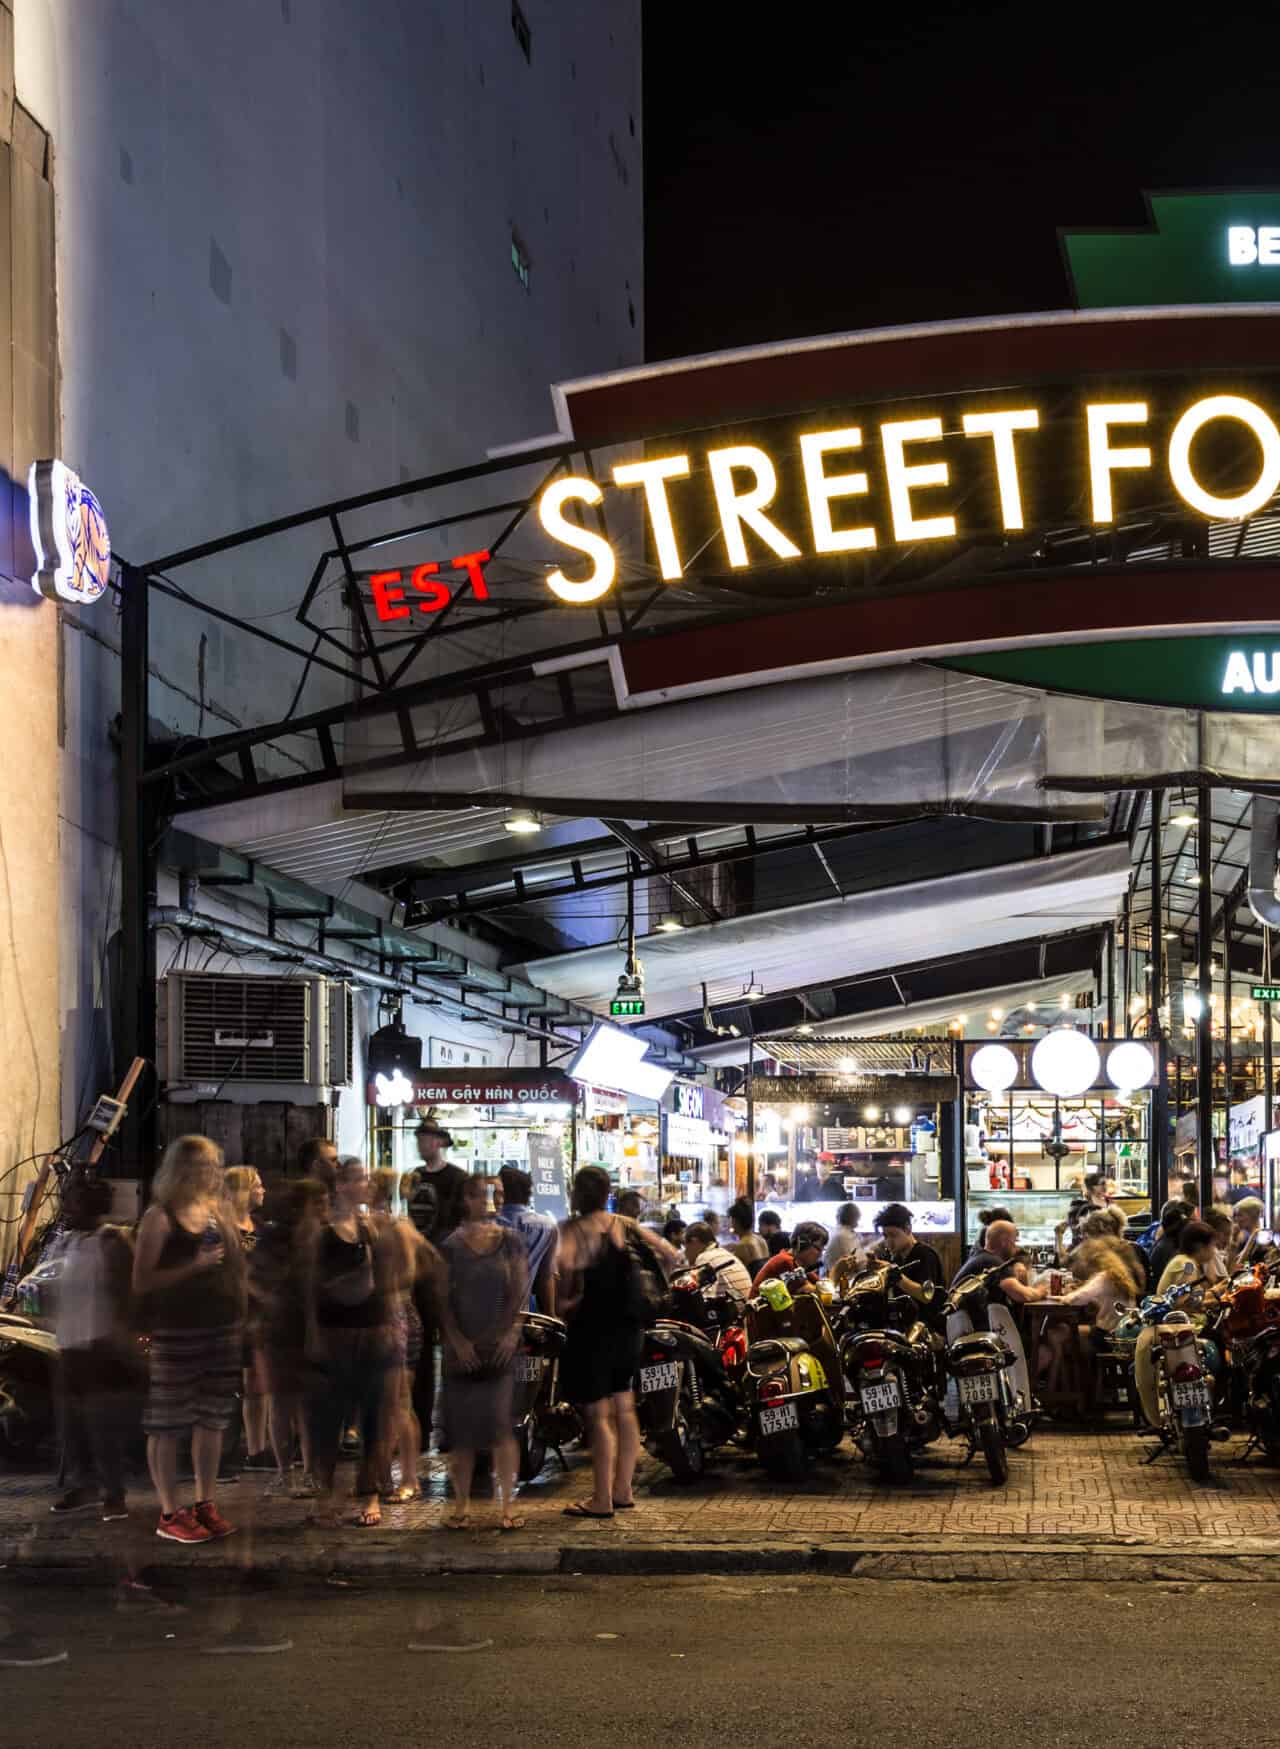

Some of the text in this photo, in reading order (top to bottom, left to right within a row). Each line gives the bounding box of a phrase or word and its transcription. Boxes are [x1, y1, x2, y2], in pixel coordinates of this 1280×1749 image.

[538, 409, 1040, 604] STREET
[370, 550, 490, 622] EST
[612, 1002, 643, 1015] EXIT
[418, 1087, 448, 1100] KEM
[452, 1084, 480, 1104] GẬY
[485, 1084, 513, 1100] HÀN
[541, 1170, 554, 1184] ICE
